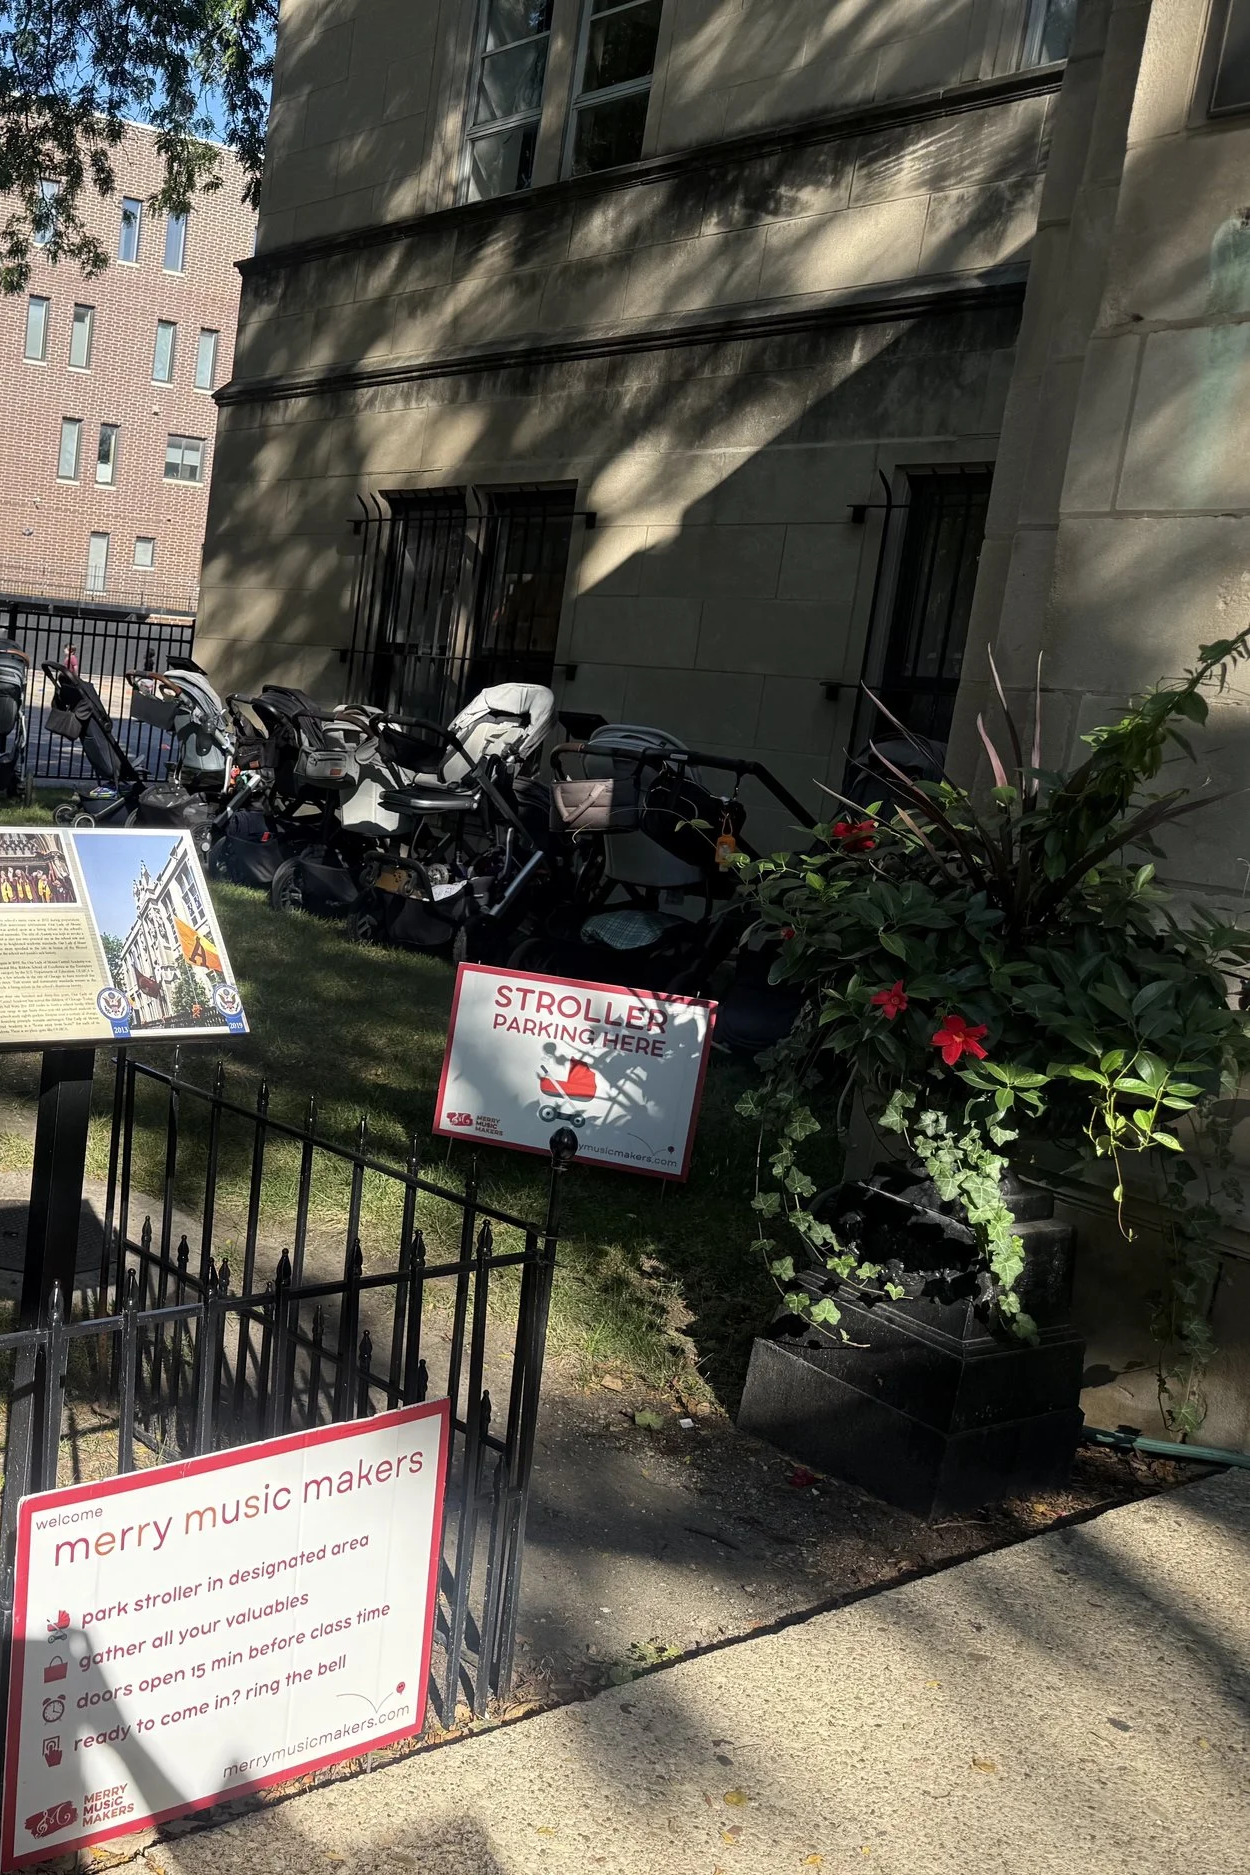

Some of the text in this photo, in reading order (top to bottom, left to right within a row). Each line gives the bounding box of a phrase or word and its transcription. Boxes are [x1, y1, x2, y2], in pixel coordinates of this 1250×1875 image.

[494, 985, 668, 1034] STROLLER
[493, 1013, 666, 1058] PARKING HERE
[475, 1126, 503, 1136] MAKERS
[476, 1115, 501, 1124] MERRY
[578, 1143, 677, 1168] ymusicmakers.com
[35, 1506, 103, 1531] welcome
[54, 1449, 423, 1566] merry music makers
[81, 1534, 369, 1629] park stroller in designated area
[79, 1593, 309, 1672] gather all your valuables
[76, 1604, 391, 1709] doors open 15 min before class time
[74, 1654, 347, 1751] ready to come in? ring the bell
[223, 1704, 410, 1778] merrymusicmakers.com
[82, 1803, 135, 1828] MAKERS
[84, 1783, 128, 1805] MERRY
